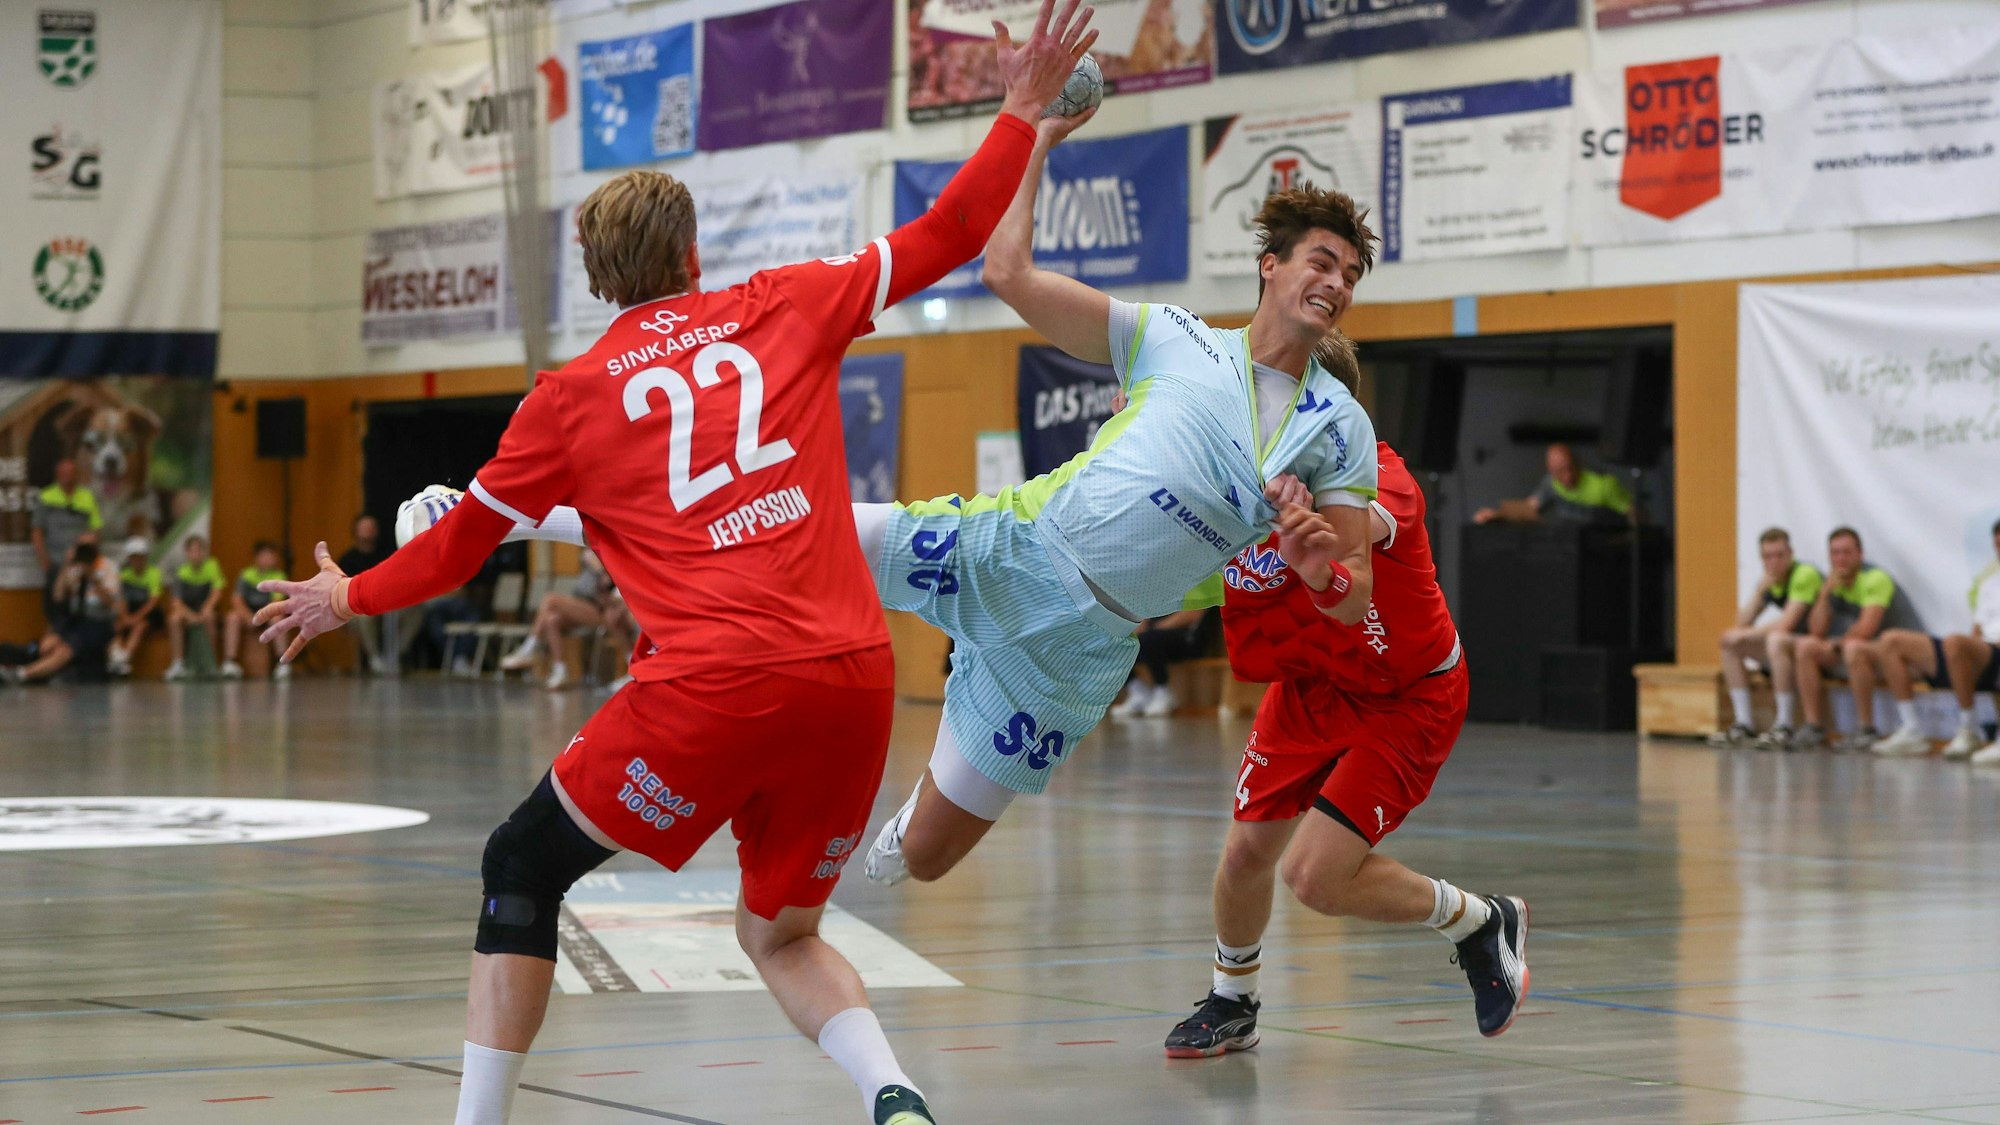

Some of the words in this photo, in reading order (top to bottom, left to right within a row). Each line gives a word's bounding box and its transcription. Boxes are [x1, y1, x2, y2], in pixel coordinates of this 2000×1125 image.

[1629, 74, 1715, 112] OTTO
[1581, 112, 1764, 158] SCHRÖDER
[607, 322, 740, 377] SINKABERG
[1164, 306, 1220, 364] Profizelt24
[622, 341, 797, 513] 22
[707, 485, 811, 550] JEPPSSON
[617, 782, 676, 830] 1000
[625, 757, 697, 819] REMA
